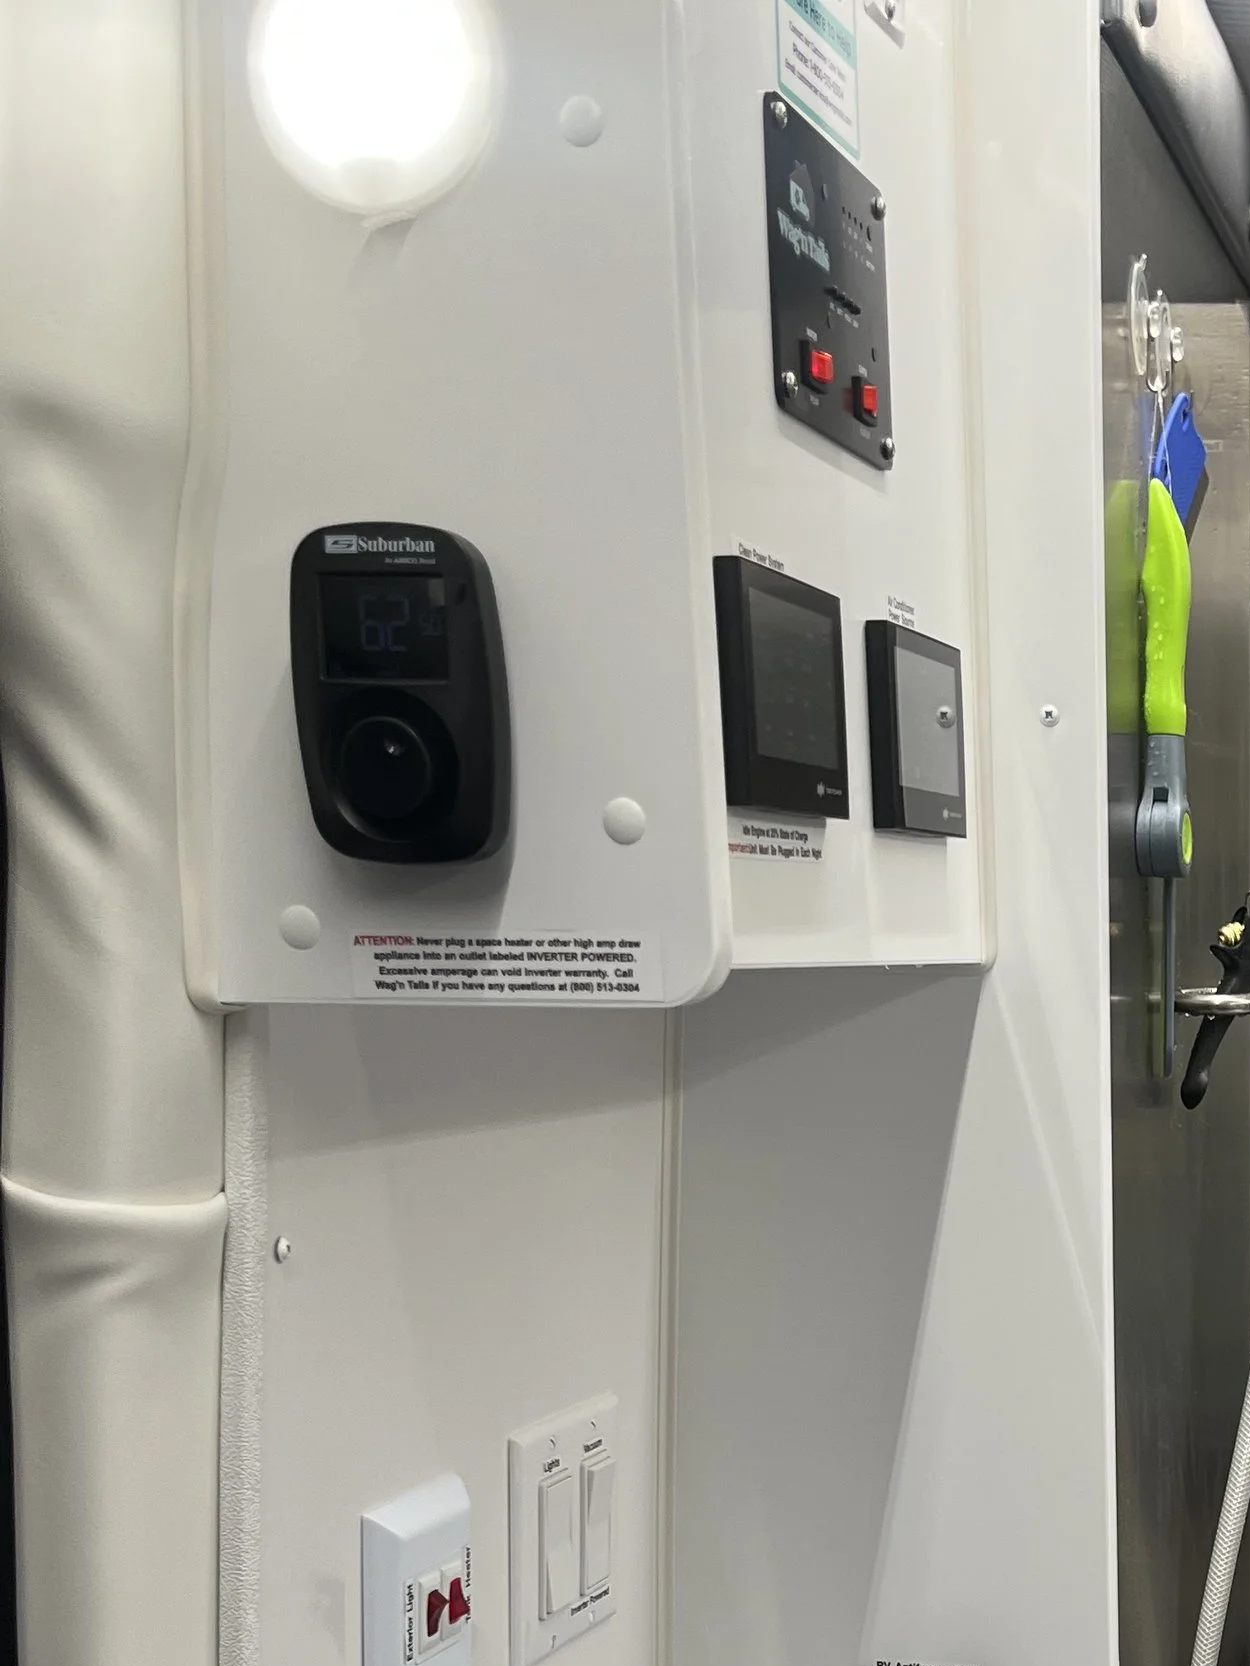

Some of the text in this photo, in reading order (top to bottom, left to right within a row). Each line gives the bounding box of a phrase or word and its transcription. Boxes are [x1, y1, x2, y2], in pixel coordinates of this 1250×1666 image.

[358, 536, 436, 553] Suburban
[353, 935, 414, 947] ATTENTION:
[416, 937, 442, 946] Never
[445, 938, 466, 948] plug
[475, 939, 502, 948] space
[504, 938, 533, 947] heater
[547, 938, 572, 947] other
[573, 938, 594, 949] high
[596, 940, 616, 949] amp
[618, 939, 641, 948] draw
[373, 950, 420, 962] appliance
[444, 952, 456, 960] an
[459, 951, 487, 960] outlet
[488, 951, 524, 961] labeled
[526, 952, 578, 962] INVERTER
[581, 952, 637, 963] POWERED.
[378, 966, 428, 976] Excessive
[431, 967, 478, 978] amperage
[480, 968, 498, 976] can
[501, 967, 522, 977] void
[564, 969, 609, 980] warranty.
[614, 968, 634, 978] Call
[375, 980, 405, 992] Wag'n
[407, 980, 429, 990] Tails
[441, 981, 460, 992] you
[462, 980, 485, 990] have
[487, 982, 505, 993] any
[508, 982, 555, 993] questions
[558, 982, 568, 991] at
[543, 1459, 560, 1473] Lights
[406, 1584, 414, 1662] Exterior Light
